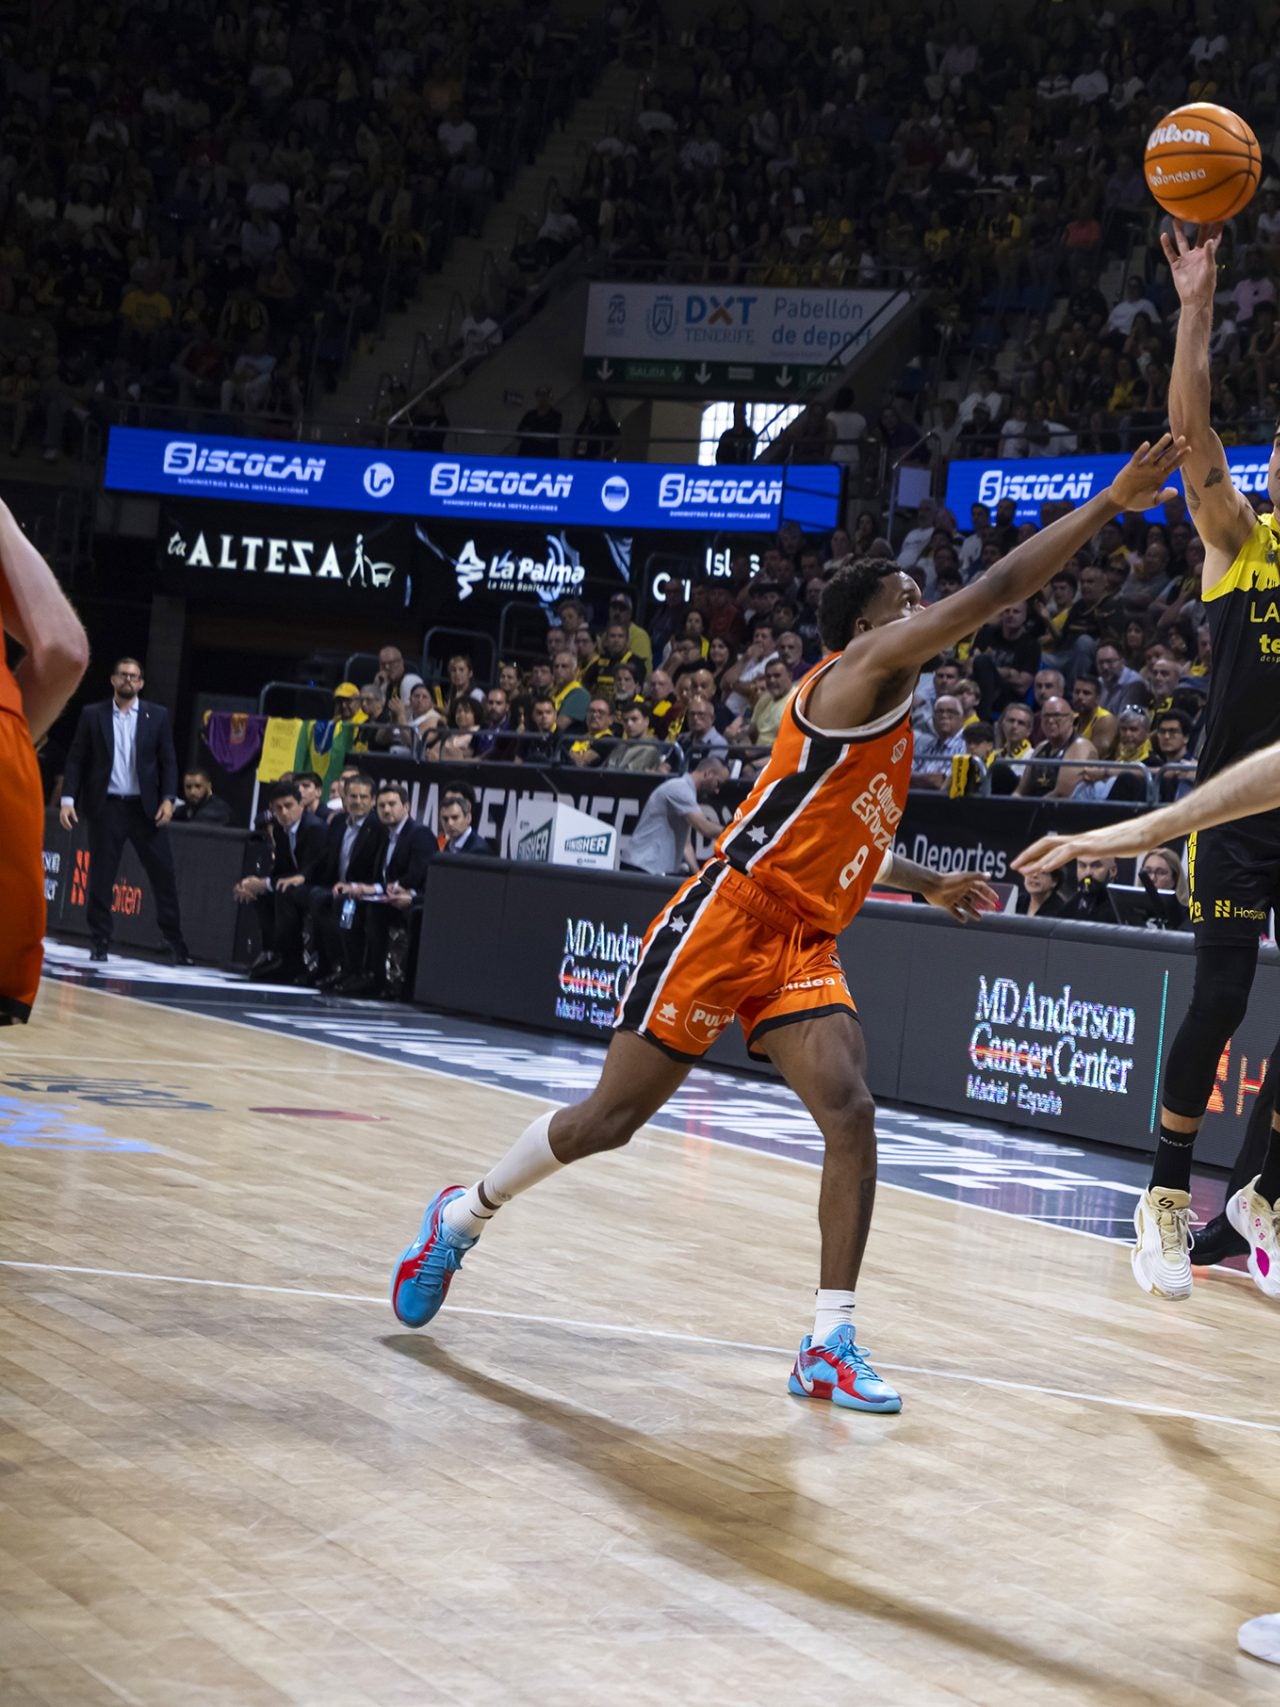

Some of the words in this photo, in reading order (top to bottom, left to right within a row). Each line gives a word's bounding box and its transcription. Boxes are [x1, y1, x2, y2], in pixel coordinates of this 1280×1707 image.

[686, 296, 758, 325] DXT
[774, 297, 863, 320] Pabellón
[772, 324, 796, 345] de
[488, 555, 515, 580] La
[517, 557, 586, 584] Palma
[706, 548, 760, 578] Isls
[1250, 601, 1280, 623] LA
[839, 845, 869, 890] 8
[592, 921, 642, 965] Ander
[974, 974, 1021, 1026] MD
[1017, 981, 1136, 1045] Anderson
[968, 1021, 1054, 1080] Cancer
[1053, 1034, 1134, 1095] Center
